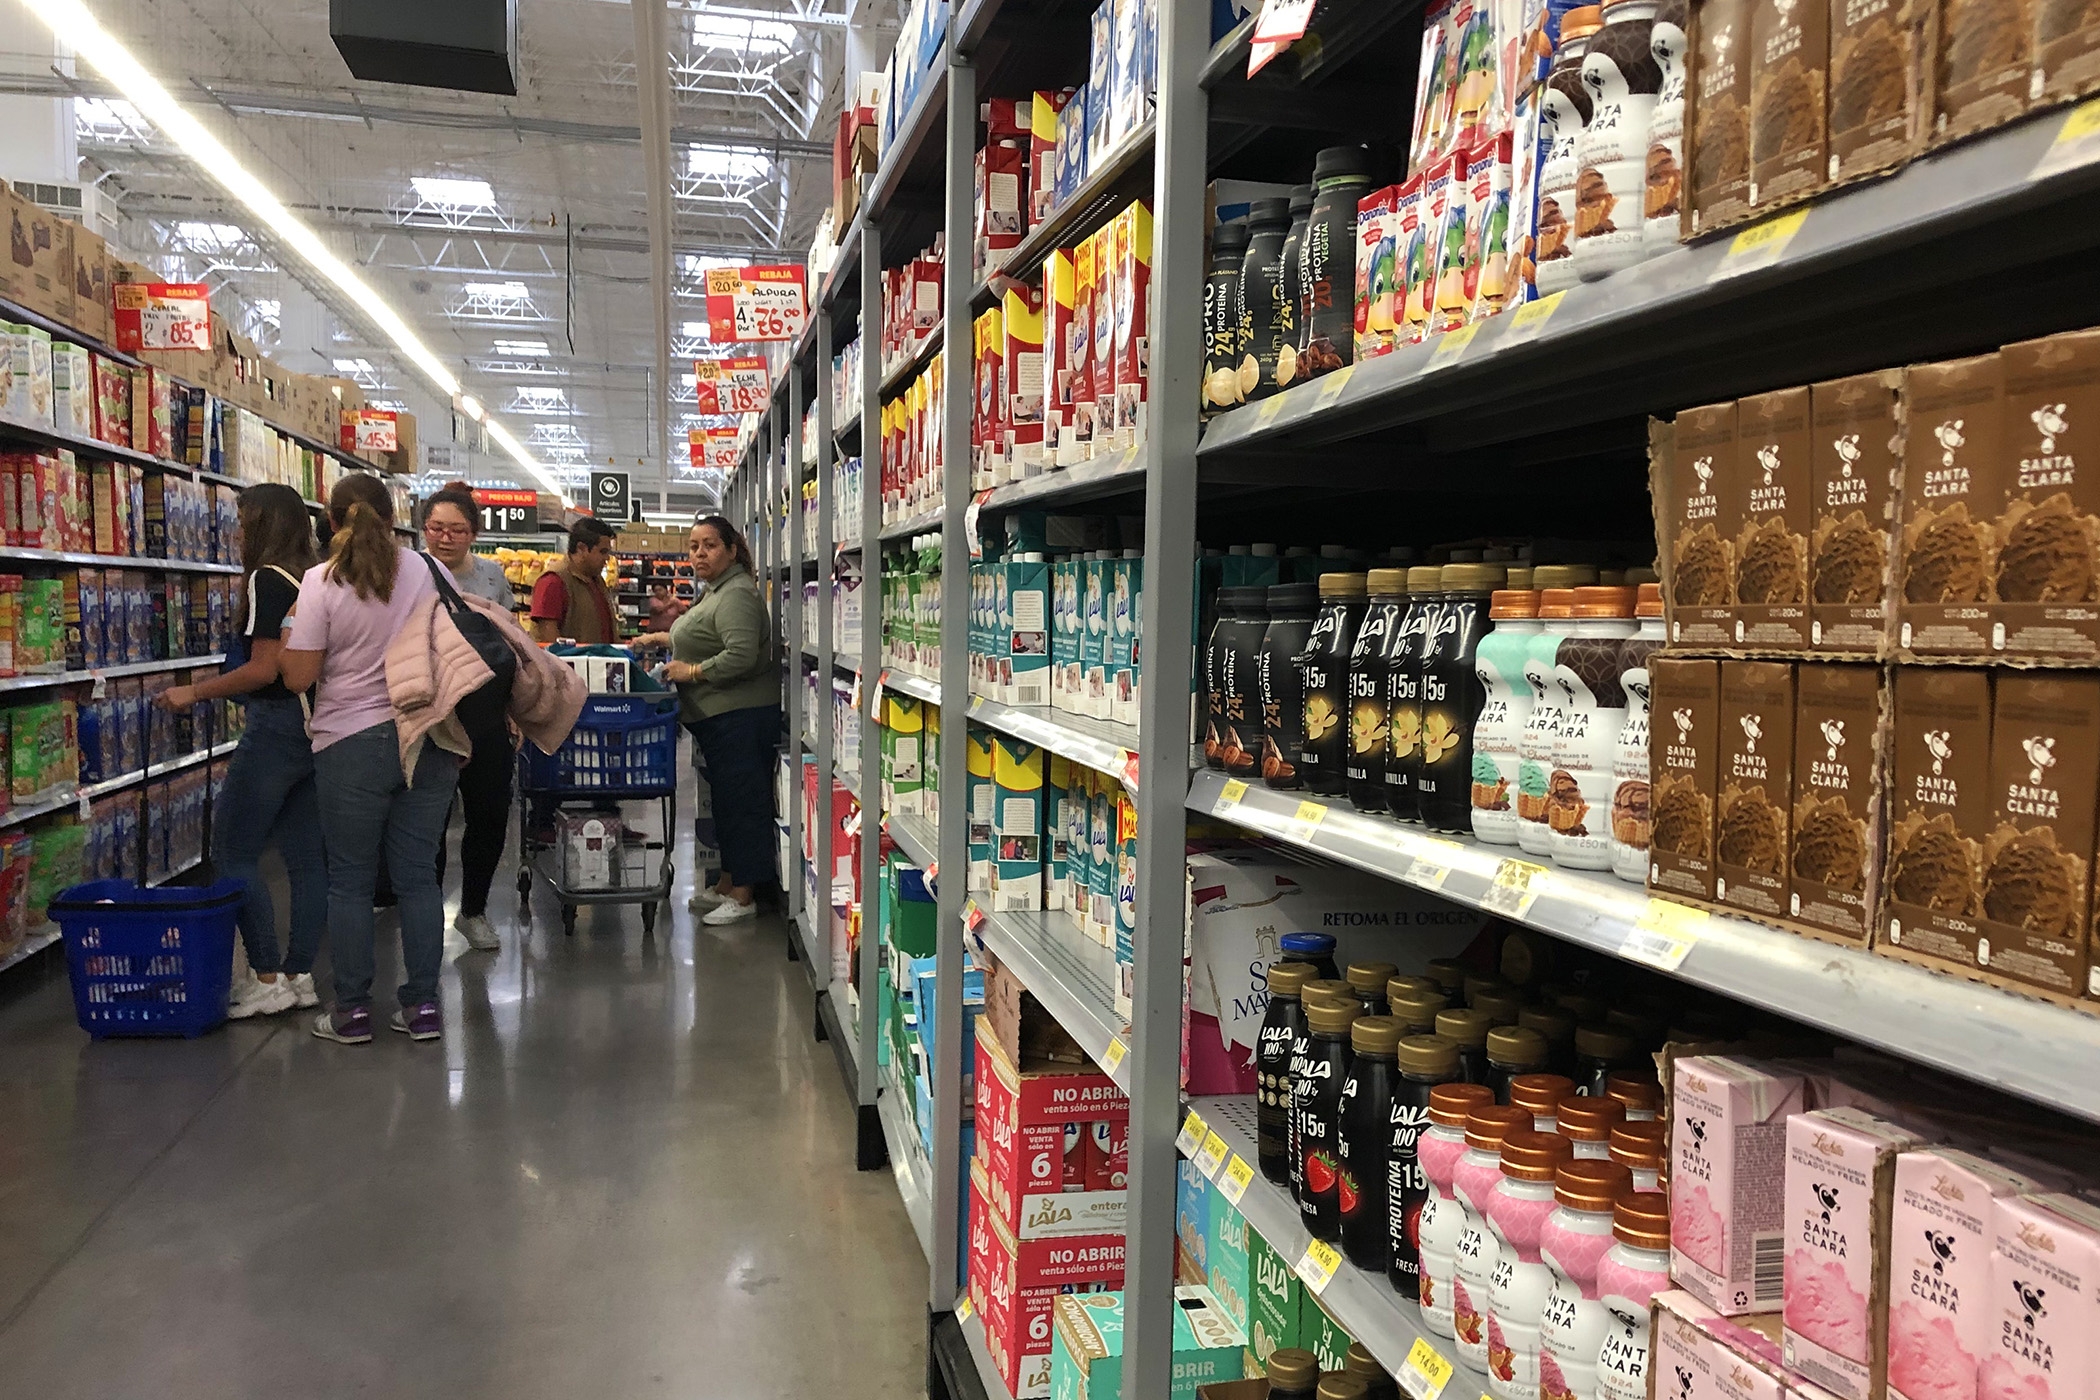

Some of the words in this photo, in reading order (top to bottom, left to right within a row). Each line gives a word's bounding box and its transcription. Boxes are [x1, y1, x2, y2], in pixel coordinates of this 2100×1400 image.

[1766, 25, 1801, 51] SANTA
[1765, 38, 1802, 64] CLARA
[1705, 63, 1736, 85] SANTA
[1705, 75, 1735, 98] CLARA
[1358, 207, 1389, 226] Danonino
[1321, 221, 1329, 263] VEGETAL
[1607, 234, 1631, 243] 250
[1312, 223, 1322, 281] PROTEÍNA
[759, 270, 793, 279] REBAJA
[752, 288, 797, 296] ALPURA
[736, 307, 746, 323] 4
[1216, 283, 1227, 331] PROTEÍNA
[2019, 455, 2075, 472] SANTA
[1925, 467, 1970, 484] SANTA
[2018, 471, 2074, 488] CLARA
[1750, 486, 1786, 500] SANTA
[1827, 478, 1866, 493] SANTA
[1923, 481, 1969, 498] CLARA
[514, 494, 532, 502] BAJO
[1687, 495, 1717, 508] SANTA
[1750, 498, 1786, 512] CLARA
[1827, 492, 1867, 506] CLARA
[1687, 506, 1717, 519] CLARA
[1228, 650, 1236, 697] PROTEÍNA
[1262, 652, 1272, 703] PROTEÍNA
[1305, 666, 1326, 688] 15g
[1352, 673, 1376, 698] 15g
[1392, 674, 1417, 698] 15g
[1423, 675, 1446, 701] 15g
[1623, 720, 1648, 732] SAN
[1667, 745, 1696, 758] SANTA
[1666, 756, 1696, 769] CLARA
[1733, 754, 1767, 767] SANTA
[1732, 765, 1767, 780] CLARA
[1812, 762, 1849, 777] SANTA
[1810, 774, 1848, 790] CLARA
[1916, 775, 1957, 792] SANTA
[1915, 789, 1956, 807] CLARA
[2008, 784, 2059, 804] SANTA
[2007, 800, 2058, 819] CLARA
[1093, 830, 1106, 846] LALA
[1579, 840, 1599, 849] 250
[1323, 912, 1389, 926] RETOMA
[1395, 912, 1410, 926] EL
[1415, 910, 1479, 926] ORIGEN
[1262, 1027, 1293, 1040] LALA
[1053, 1088, 1077, 1102] NO
[1044, 1106, 1068, 1114] venta
[1070, 1104, 1088, 1112] sólo
[1703, 1106, 1723, 1118] FRESA
[1036, 1126, 1060, 1134] ABRIR
[1301, 1111, 1325, 1137] 15g
[993, 1117, 1011, 1152] LALA
[1392, 1128, 1416, 1147] 100
[1031, 1152, 1051, 1178] 6
[1682, 1149, 1711, 1171] SANTA
[1403, 1164, 1427, 1190] 15
[1682, 1160, 1710, 1182] CLARA
[1792, 1155, 1825, 1172] HELADO
[1838, 1171, 1866, 1187] FRESA
[1029, 1180, 1052, 1188] piezas
[1028, 1207, 1072, 1228] LALA
[1904, 1196, 1944, 1218] HELADO
[1956, 1214, 1983, 1236] FRESA
[1220, 1216, 1243, 1252] LALA
[1804, 1219, 1847, 1246] SANTA
[1803, 1232, 1847, 1259] CLARA
[1050, 1250, 1074, 1264] NO
[1040, 1267, 1065, 1276] venta
[1066, 1265, 1085, 1274] sólo
[1099, 1263, 1106, 1271] 6
[1396, 1258, 1418, 1275] FRESA
[1257, 1254, 1288, 1303] LALA
[1912, 1269, 1959, 1300] SANTA
[2044, 1268, 2080, 1293] FRESA
[991, 1270, 1010, 1312] LALA
[1020, 1289, 1033, 1297] NO
[1911, 1283, 1957, 1314] CLARA
[1029, 1314, 1048, 1340] 6
[1026, 1341, 1050, 1349] piezas
[2002, 1320, 2053, 1356] SANTA
[2001, 1334, 2052, 1373] CLARA
[1173, 1361, 1215, 1378] BRIR
[1416, 1350, 1440, 1378] $14.00
[1185, 1381, 1193, 1391] 6
